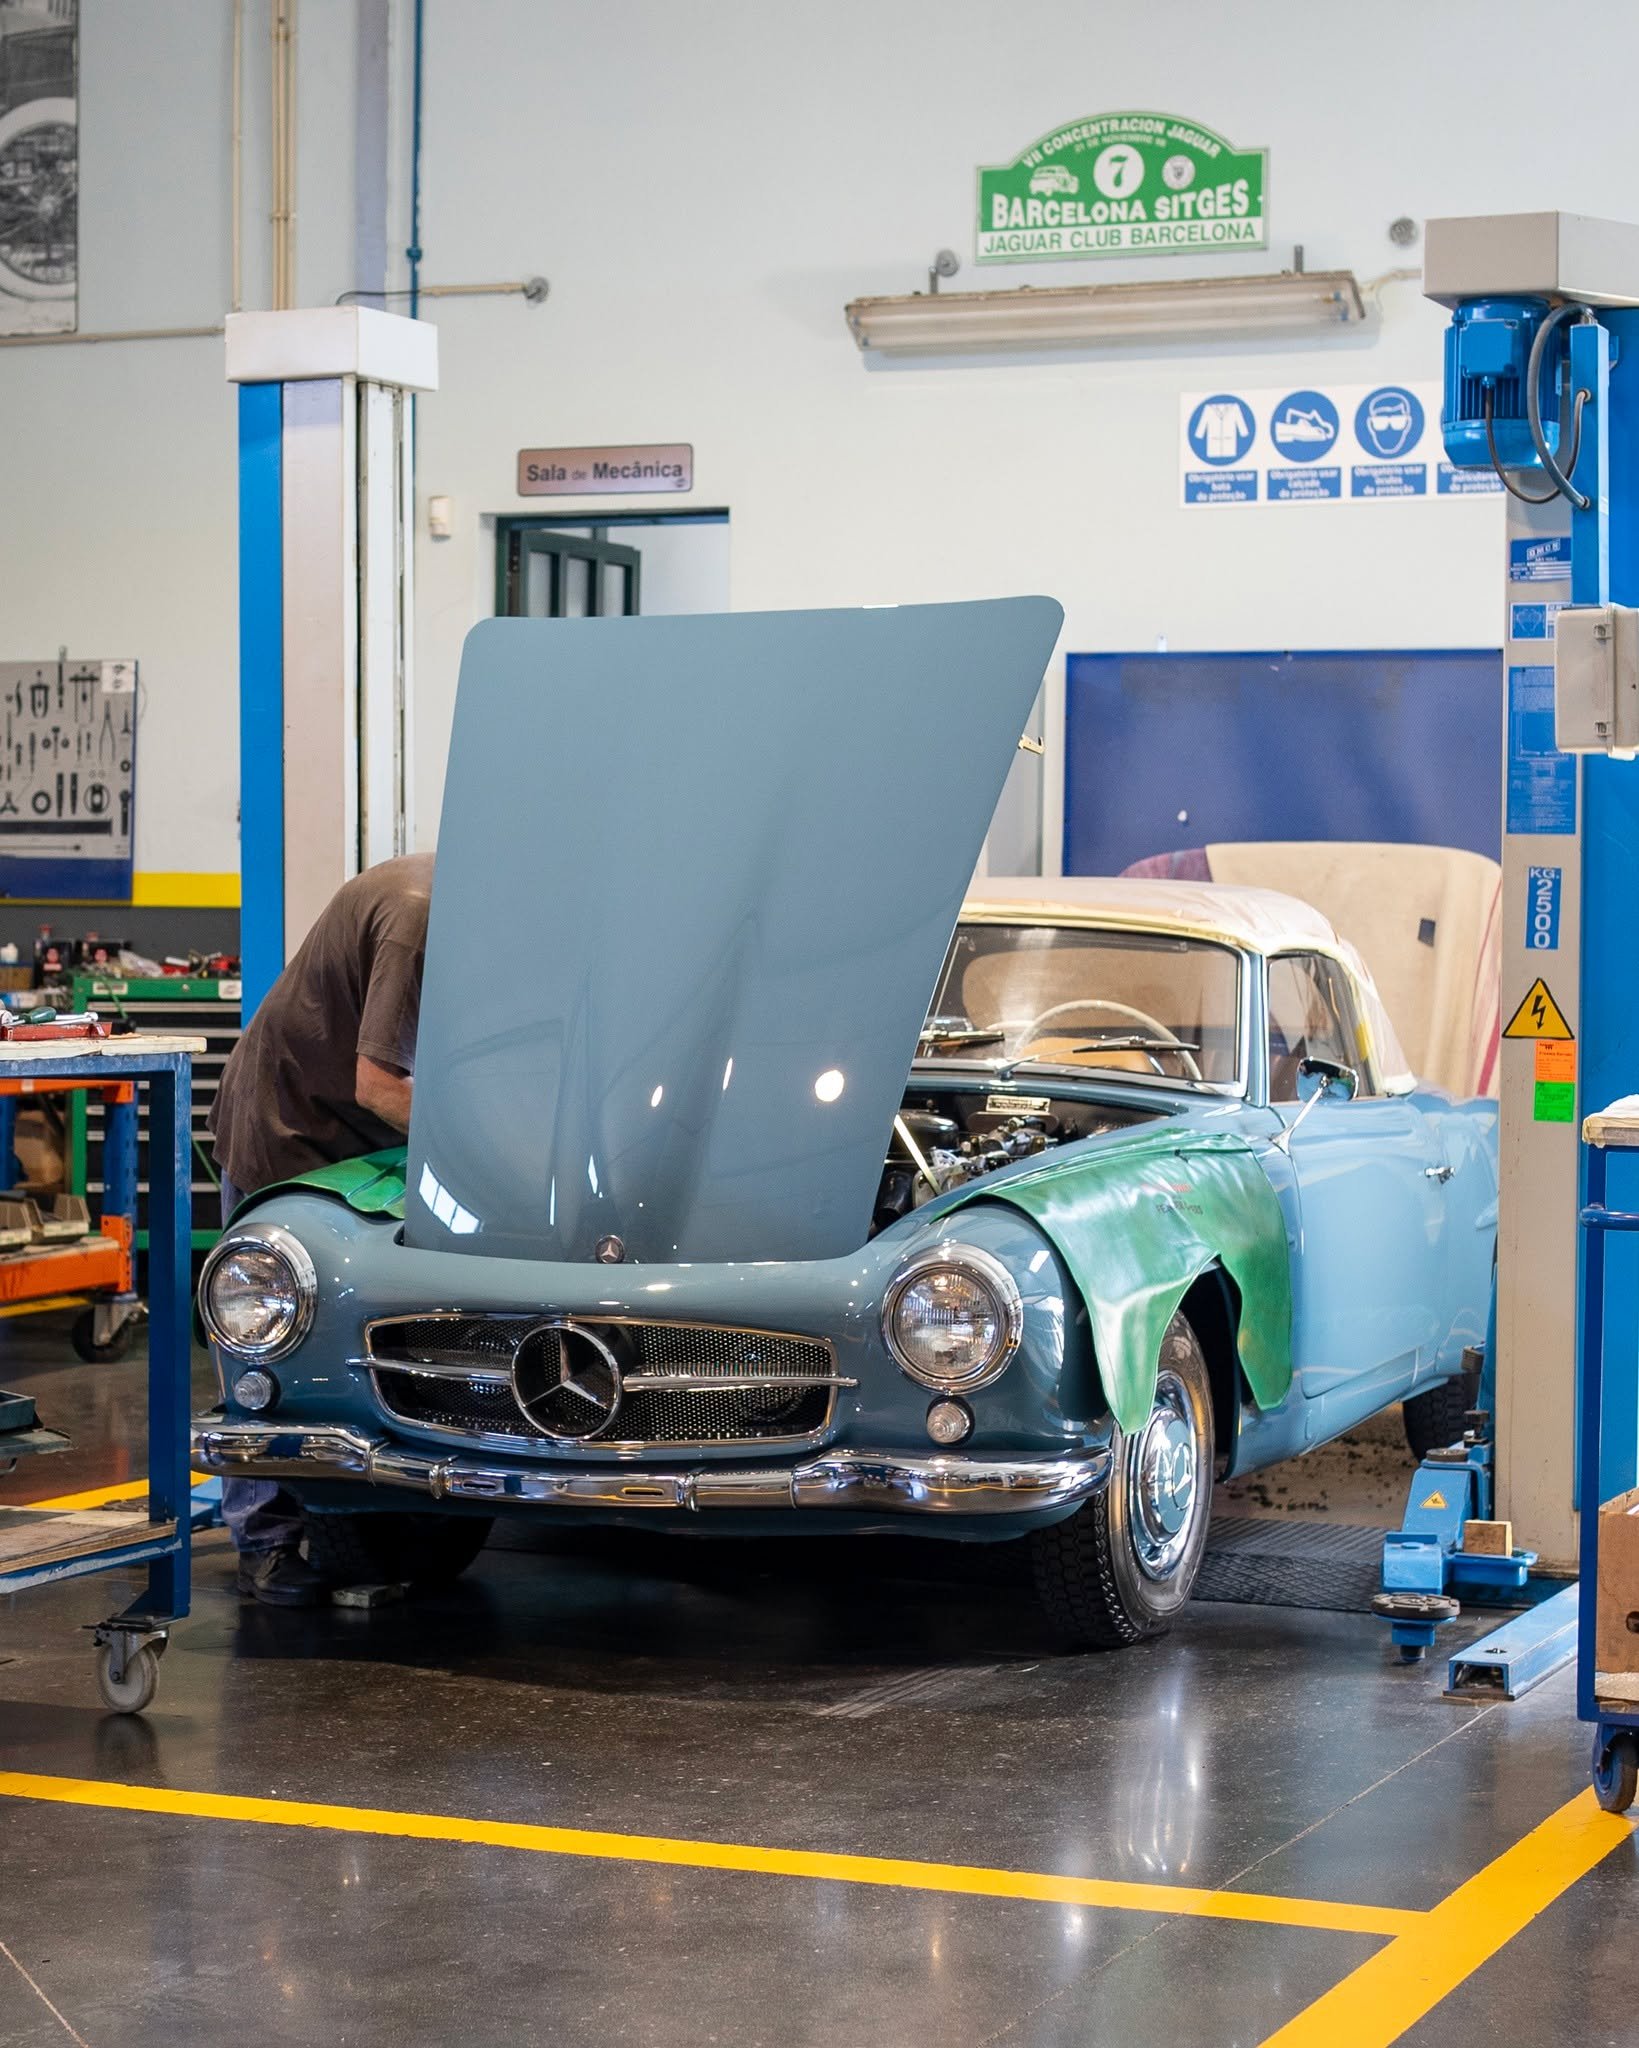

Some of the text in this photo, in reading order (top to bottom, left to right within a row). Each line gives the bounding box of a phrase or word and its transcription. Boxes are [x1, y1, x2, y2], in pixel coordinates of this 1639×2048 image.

[1023, 118, 1221, 168] VII CONCENTRACION JAGUAR
[1109, 155, 1128, 187] 7
[992, 178, 1249, 230] BARCELONA SITGES
[984, 222, 1256, 253] JAGUAR CLUB BARCELONA
[527, 460, 683, 482] Sala de Mecânica
[1530, 868, 1560, 879] KG.
[1533, 879, 1553, 949] 2500
